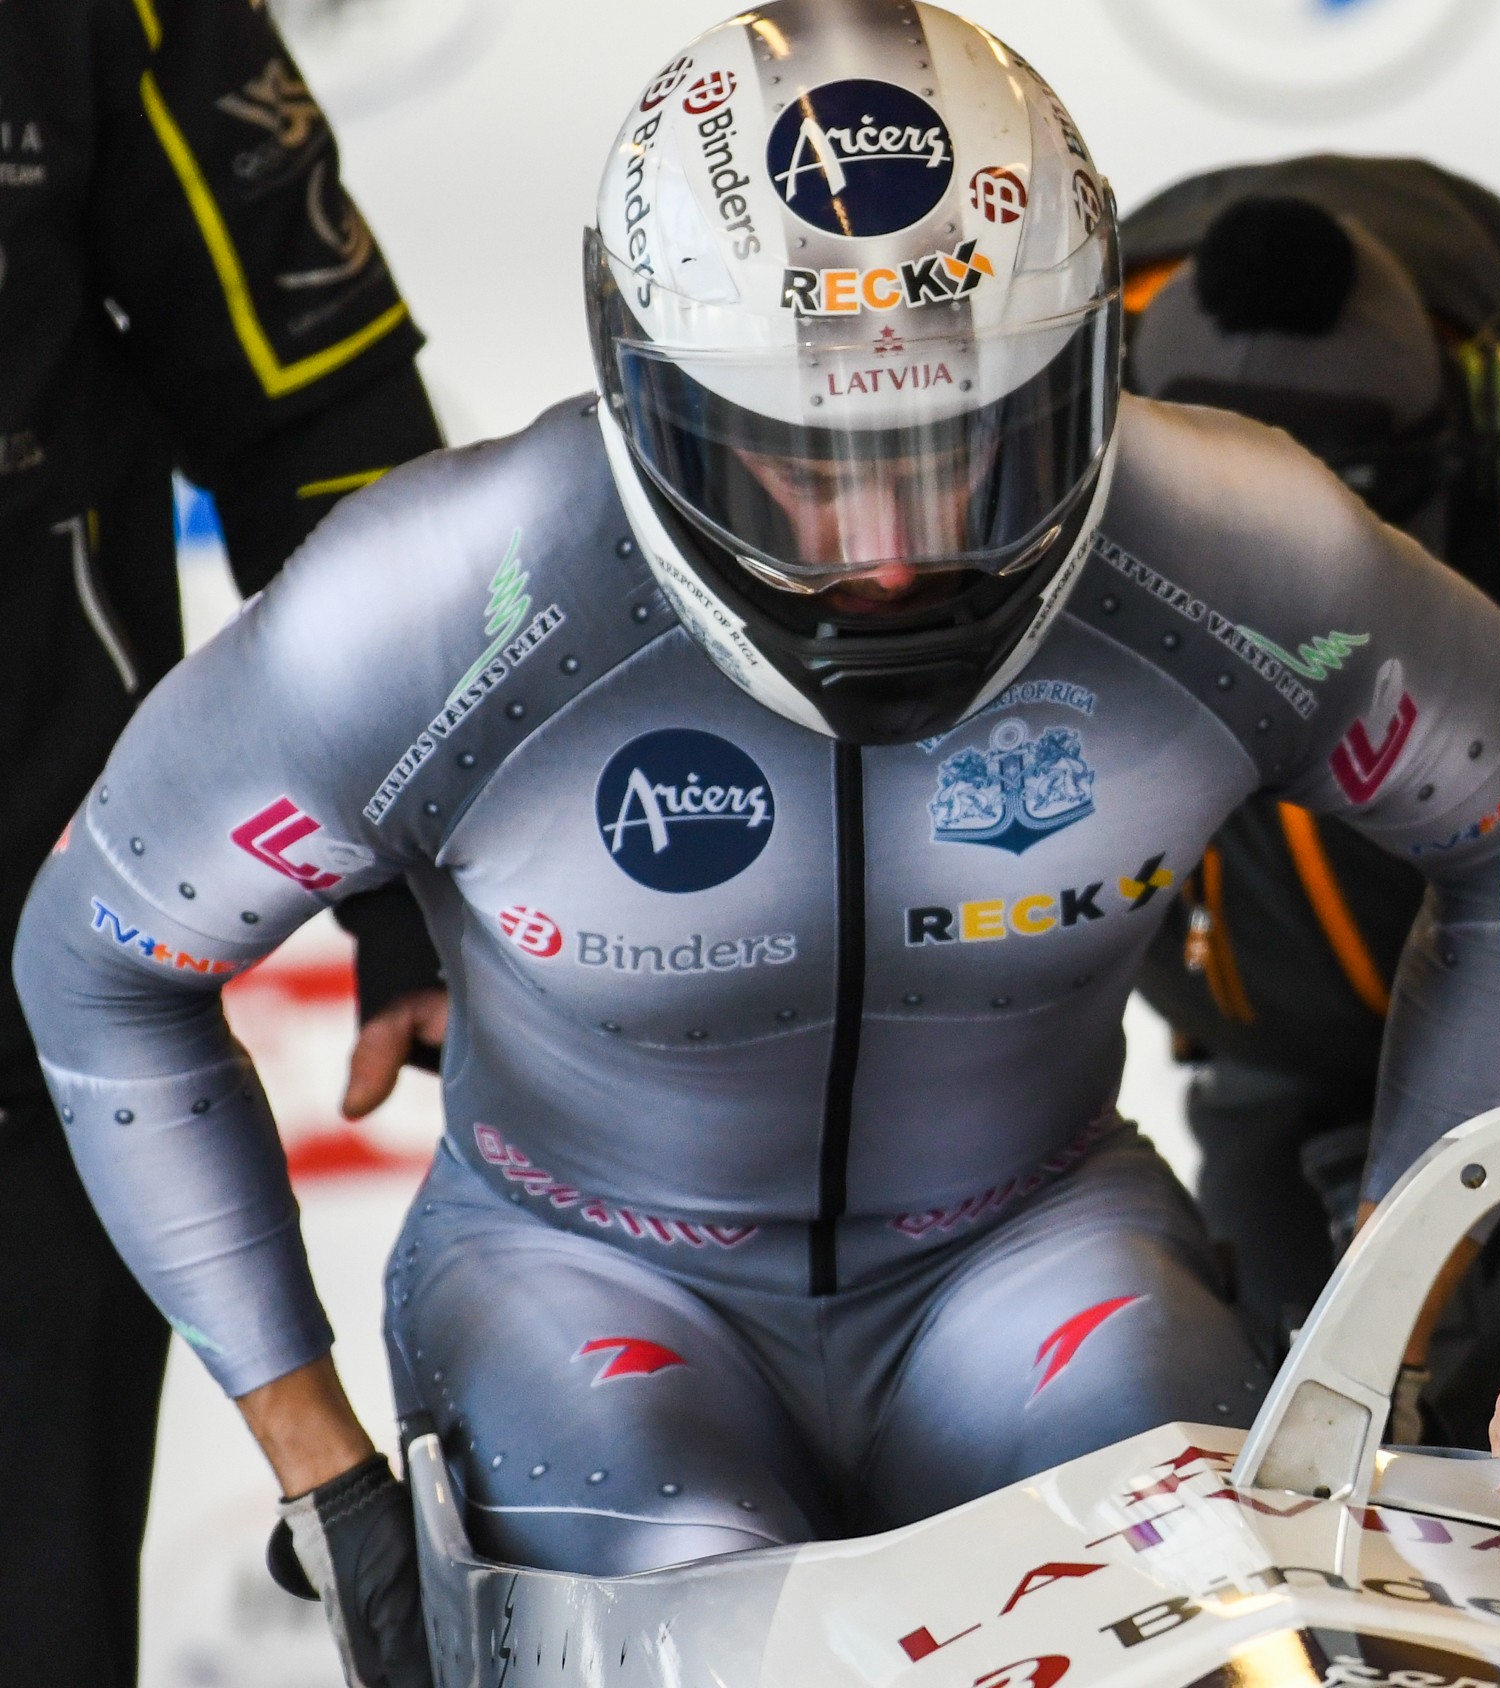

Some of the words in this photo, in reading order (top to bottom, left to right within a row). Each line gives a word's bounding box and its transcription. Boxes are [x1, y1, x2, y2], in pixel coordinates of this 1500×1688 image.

[697, 106, 761, 261] Binders
[827, 362, 953, 397] LATVIJA
[1051, 681, 1096, 715] RIGA
[366, 734, 435, 822] LATVIJAS
[431, 660, 506, 736] VALSTS
[604, 767, 770, 854] Arčers
[576, 930, 797, 974] Binders
